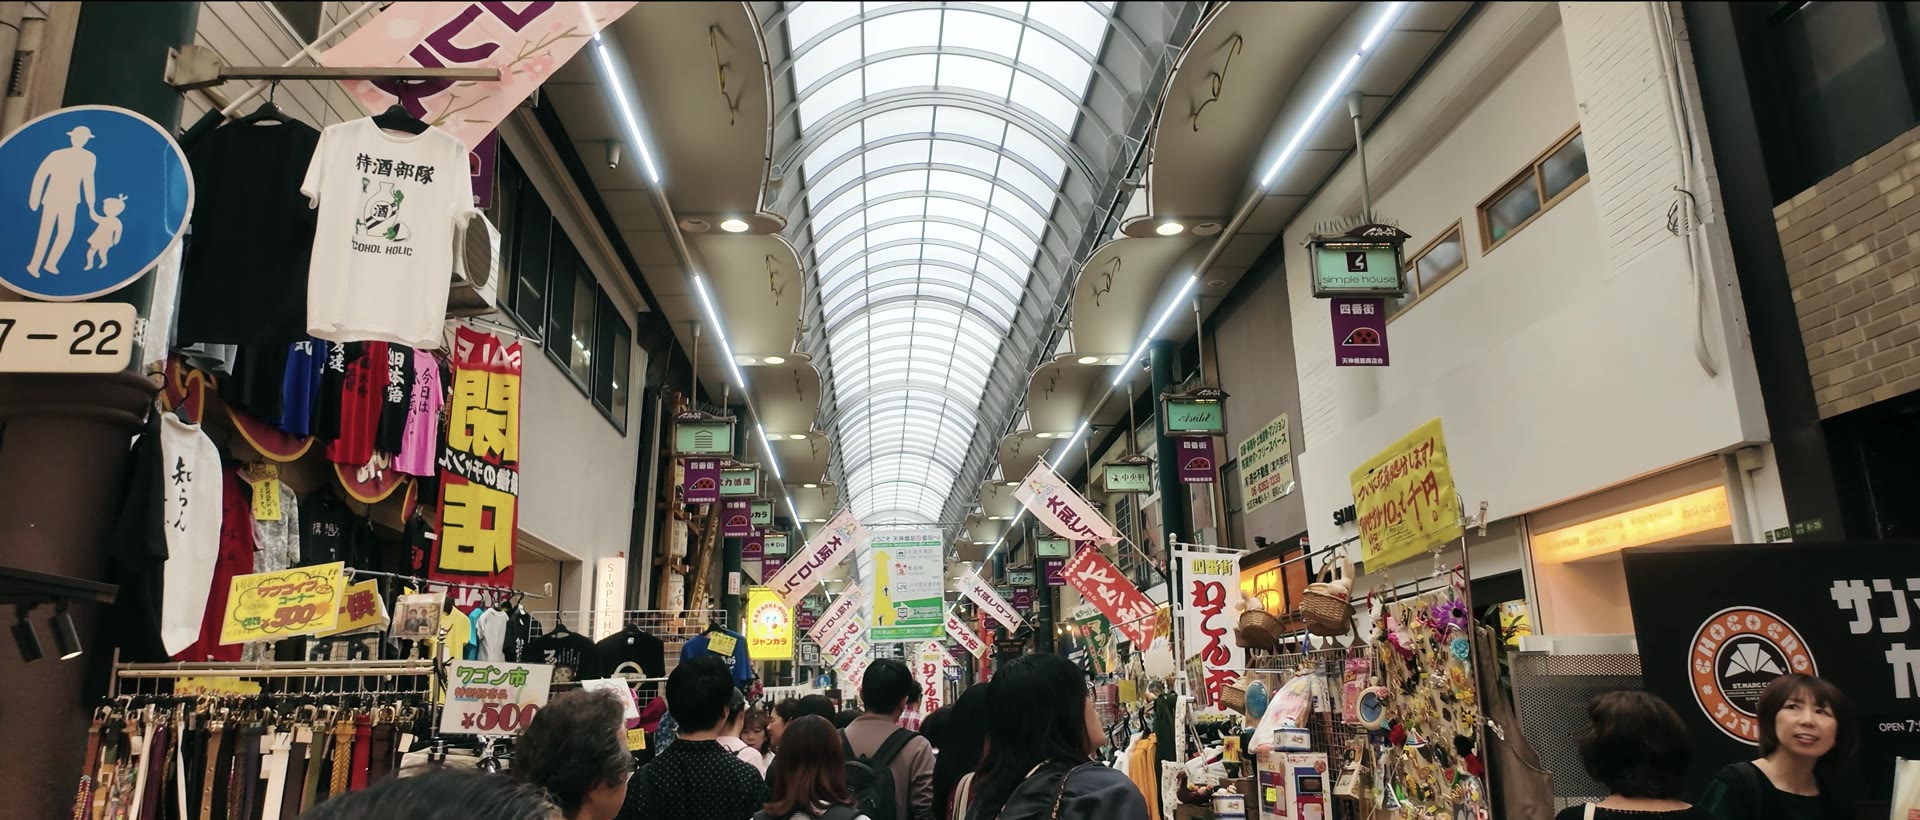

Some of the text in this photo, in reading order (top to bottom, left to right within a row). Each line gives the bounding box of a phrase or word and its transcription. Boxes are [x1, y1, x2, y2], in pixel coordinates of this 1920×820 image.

[373, 204, 389, 218] 酒
[351, 236, 413, 257] COHOL HOLIC
[1322, 274, 1397, 285] simple house
[1339, 303, 1375, 315] 四番街
[171, 456, 192, 532] 知らん
[777, 535, 843, 600] 大阪プロレス
[1192, 559, 1233, 576] 四番街
[604, 563, 614, 617] SIMPLE
[278, 593, 315, 606] コーナー
[752, 638, 787, 646] ジャンカラ
[1695, 614, 1761, 674] CHOCO
[456, 665, 530, 688] ワゴン市
[1879, 722, 1905, 732] OPEN
